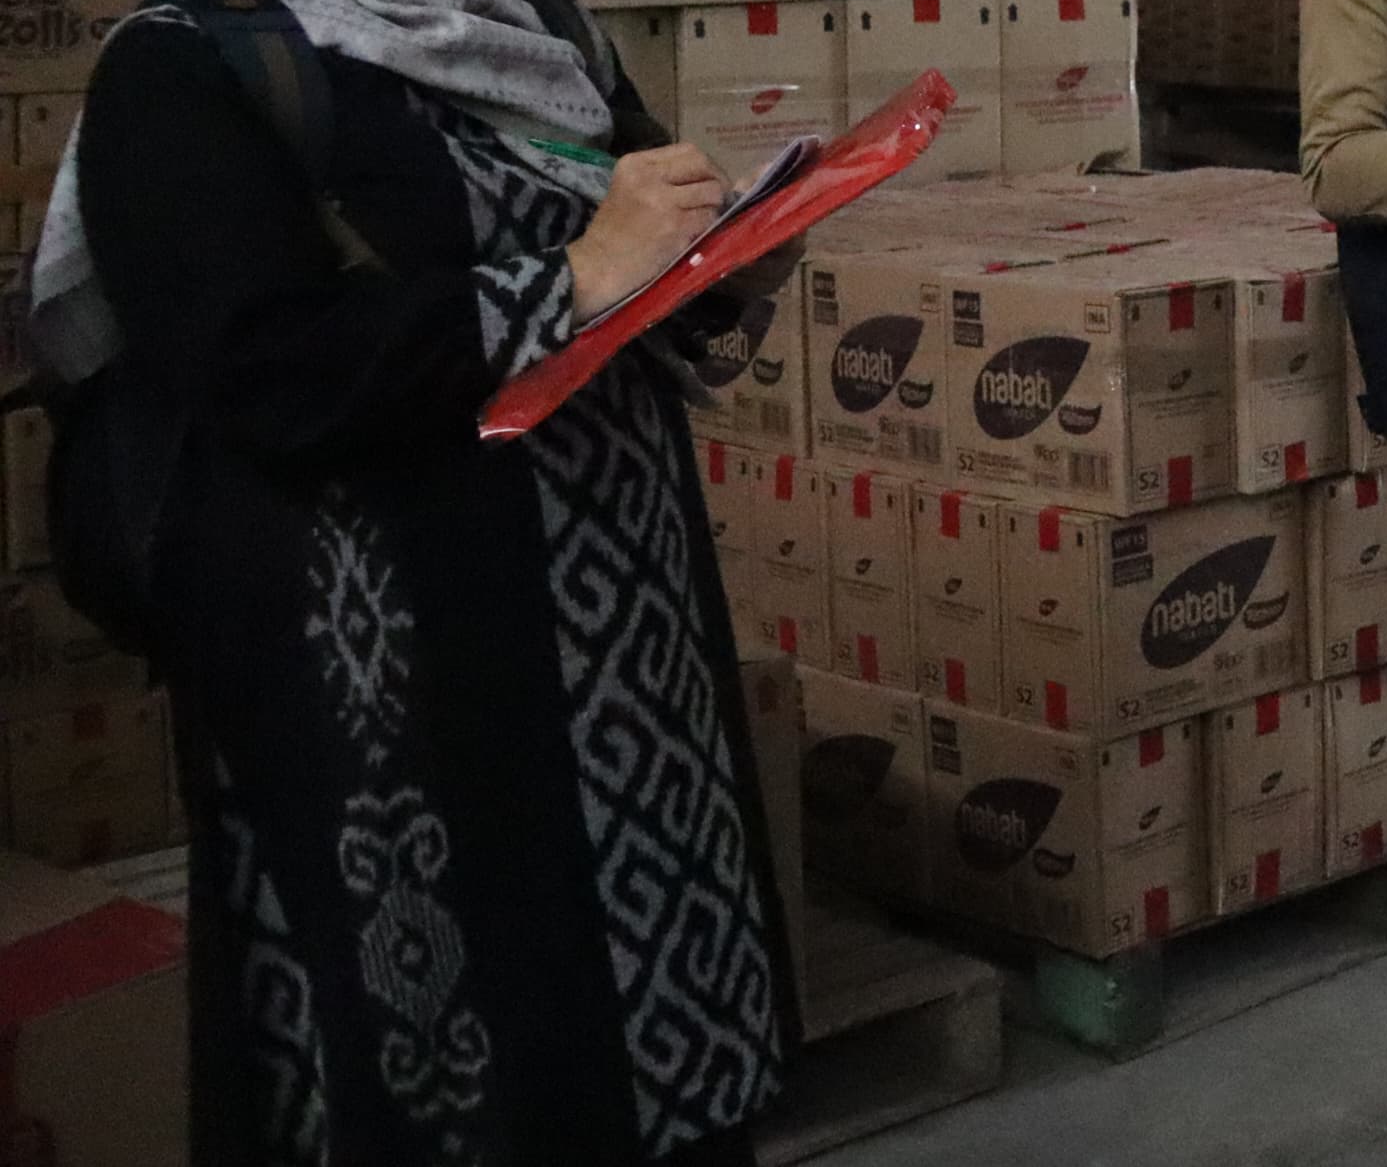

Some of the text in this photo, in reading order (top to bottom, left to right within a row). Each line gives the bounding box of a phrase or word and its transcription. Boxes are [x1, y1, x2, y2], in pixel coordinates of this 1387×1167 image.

[837, 345, 894, 386] nabati
[981, 369, 1053, 410] nabati
[958, 453, 975, 472] S2
[1260, 449, 1280, 469] S2
[1138, 471, 1160, 491] S2
[1152, 581, 1236, 638] nabati
[1330, 641, 1349, 661] S2
[1017, 685, 1034, 706] S2
[1118, 700, 1140, 720] S2
[960, 801, 1027, 850] nabati
[1342, 832, 1360, 850] S2
[1111, 916, 1132, 935] S2
